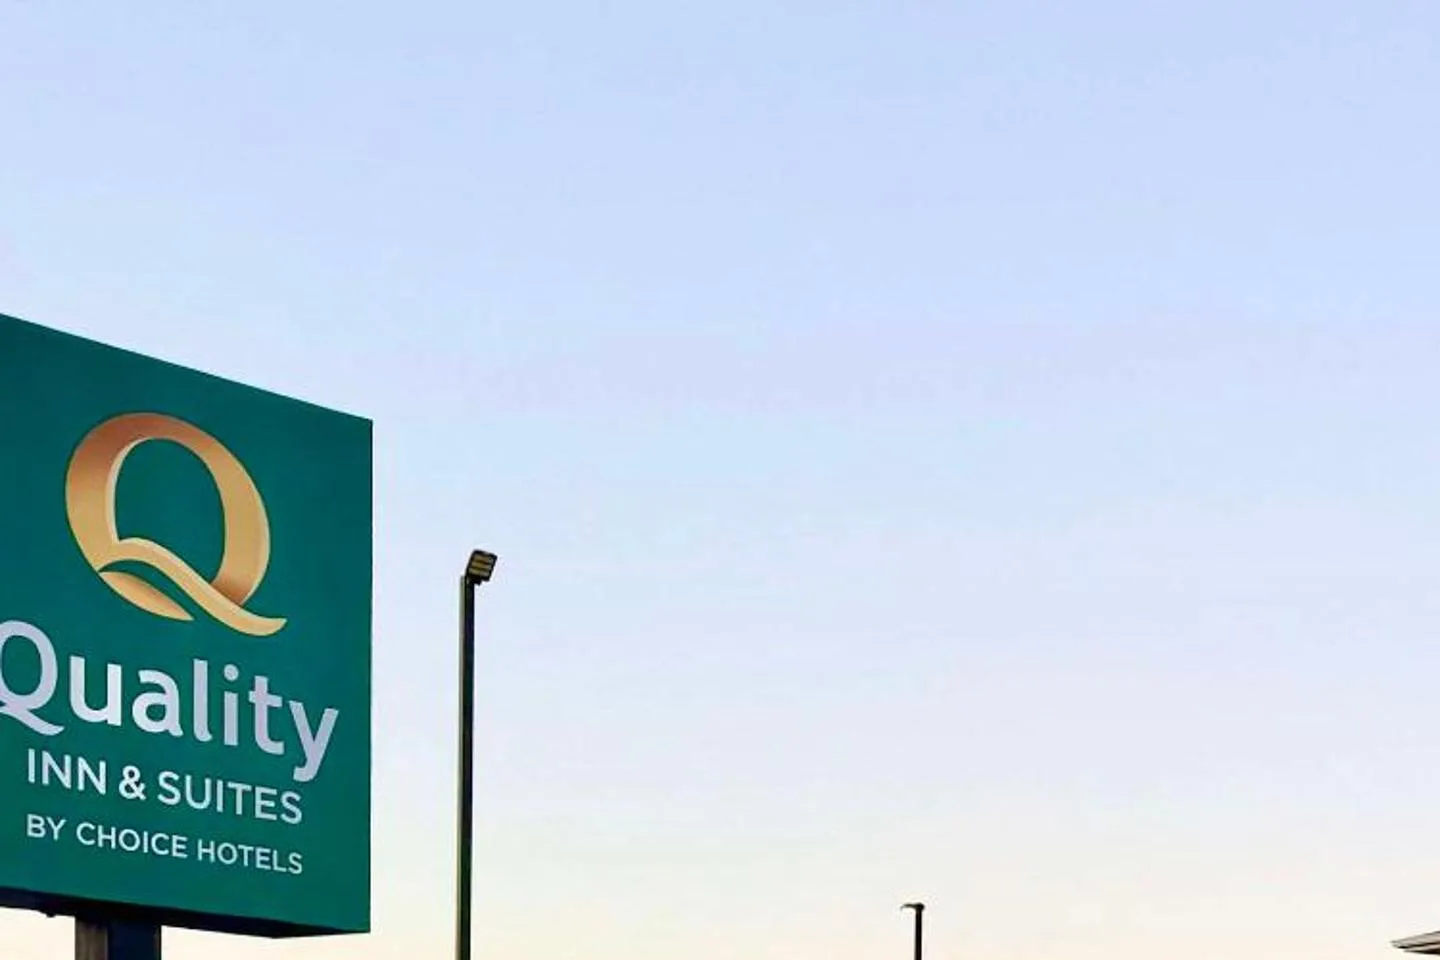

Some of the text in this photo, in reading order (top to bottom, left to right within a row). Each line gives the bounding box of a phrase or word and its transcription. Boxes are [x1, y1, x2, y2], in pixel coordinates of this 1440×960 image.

[65, 411, 287, 636] Q
[0, 619, 339, 781] Quality
[26, 813, 303, 875] BY CHOICE HOTELS
[27, 748, 303, 825] INN & SUITES
